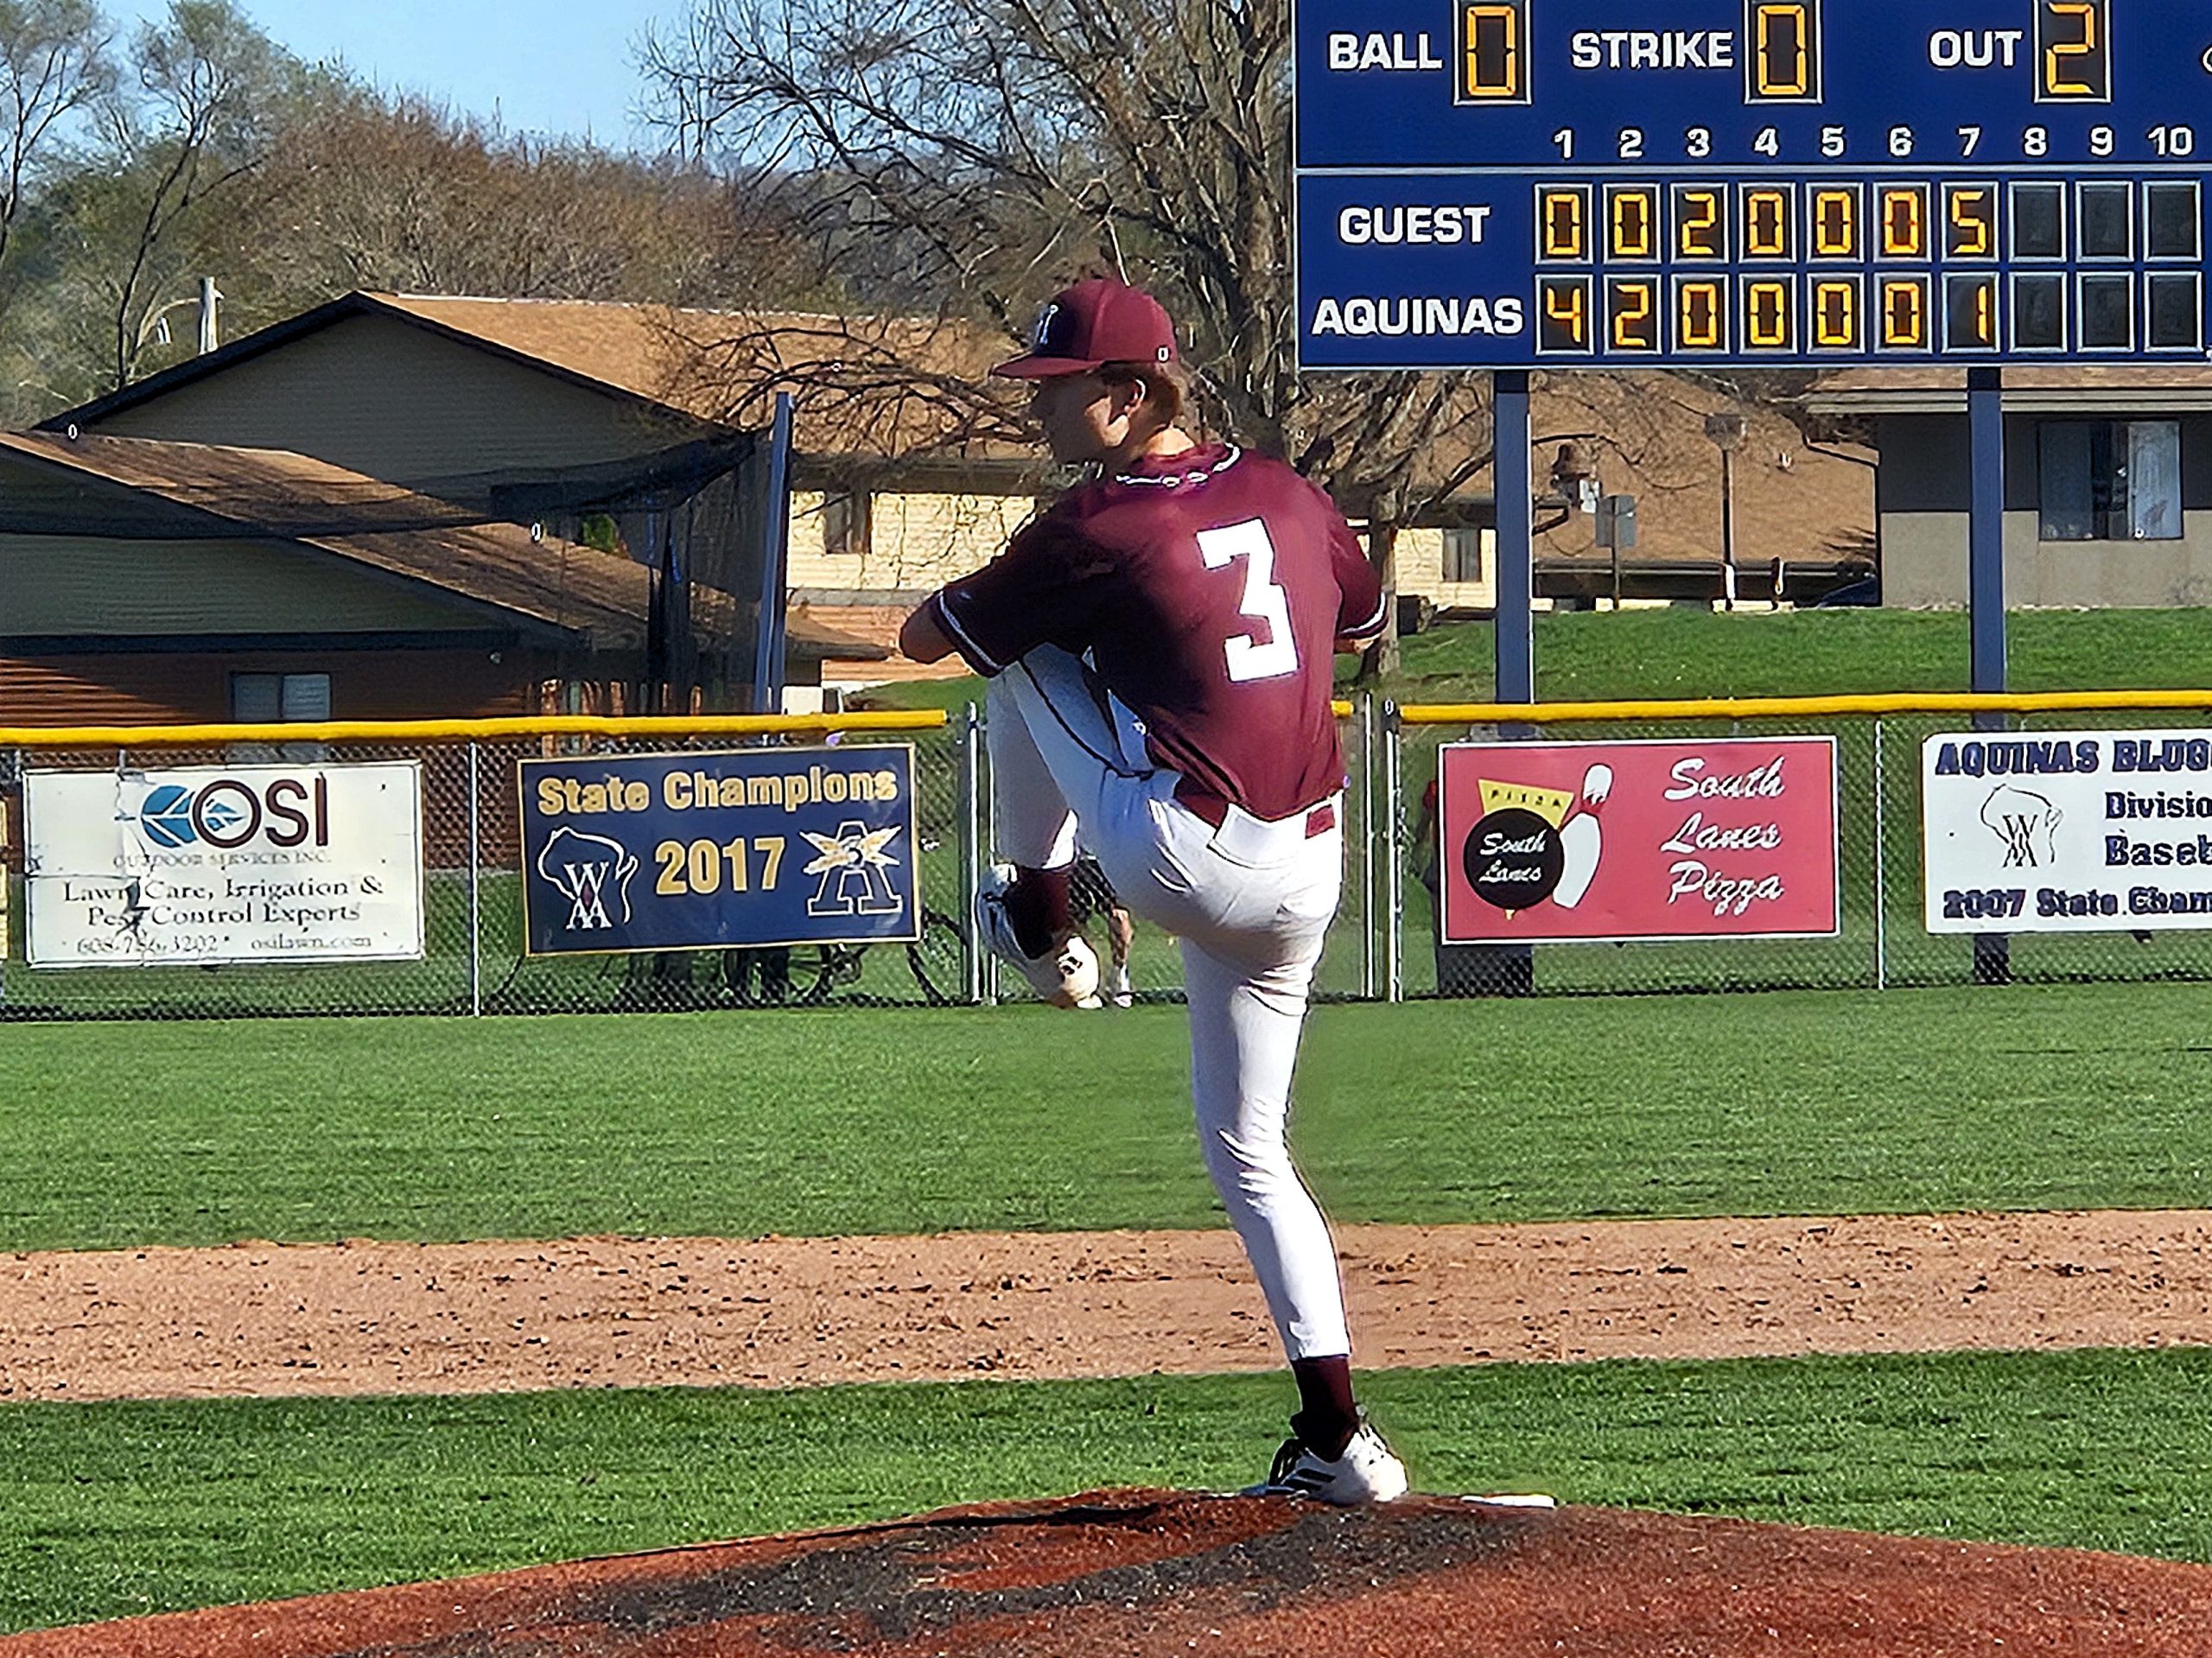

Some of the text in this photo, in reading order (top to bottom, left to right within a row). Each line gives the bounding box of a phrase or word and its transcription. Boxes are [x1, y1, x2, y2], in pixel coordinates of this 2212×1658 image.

[1328, 4, 1516, 97] BALL 0
[1571, 3, 1807, 96] STRIKE 0
[1929, 2, 2095, 94] OUT 2
[1554, 126, 2193, 159] 1 2 3 4 5 6 7 8 9 10
[1339, 190, 1986, 256] GUEST 0 0 2 0 0 0 5
[1311, 283, 1987, 346] AQUINAS 4 2 0 0 0 0 1
[1196, 518, 1299, 683] 3
[1664, 757, 1786, 802] South
[1935, 740, 2100, 778] AQUINAS
[193, 776, 329, 849] OSI
[537, 767, 899, 816] State Champions
[1479, 829, 1548, 855] South
[1660, 811, 1783, 854] Lanes
[144, 880, 213, 900] Care,
[226, 878, 348, 901] Irrigation
[360, 875, 384, 895] &
[655, 835, 785, 896] 2017
[1478, 859, 1542, 883] Lanes
[1667, 861, 1783, 917] Pizza
[152, 901, 252, 925] Control
[264, 903, 360, 925] Experts
[1942, 888, 2026, 918] 2007
[2037, 887, 2119, 917] State
